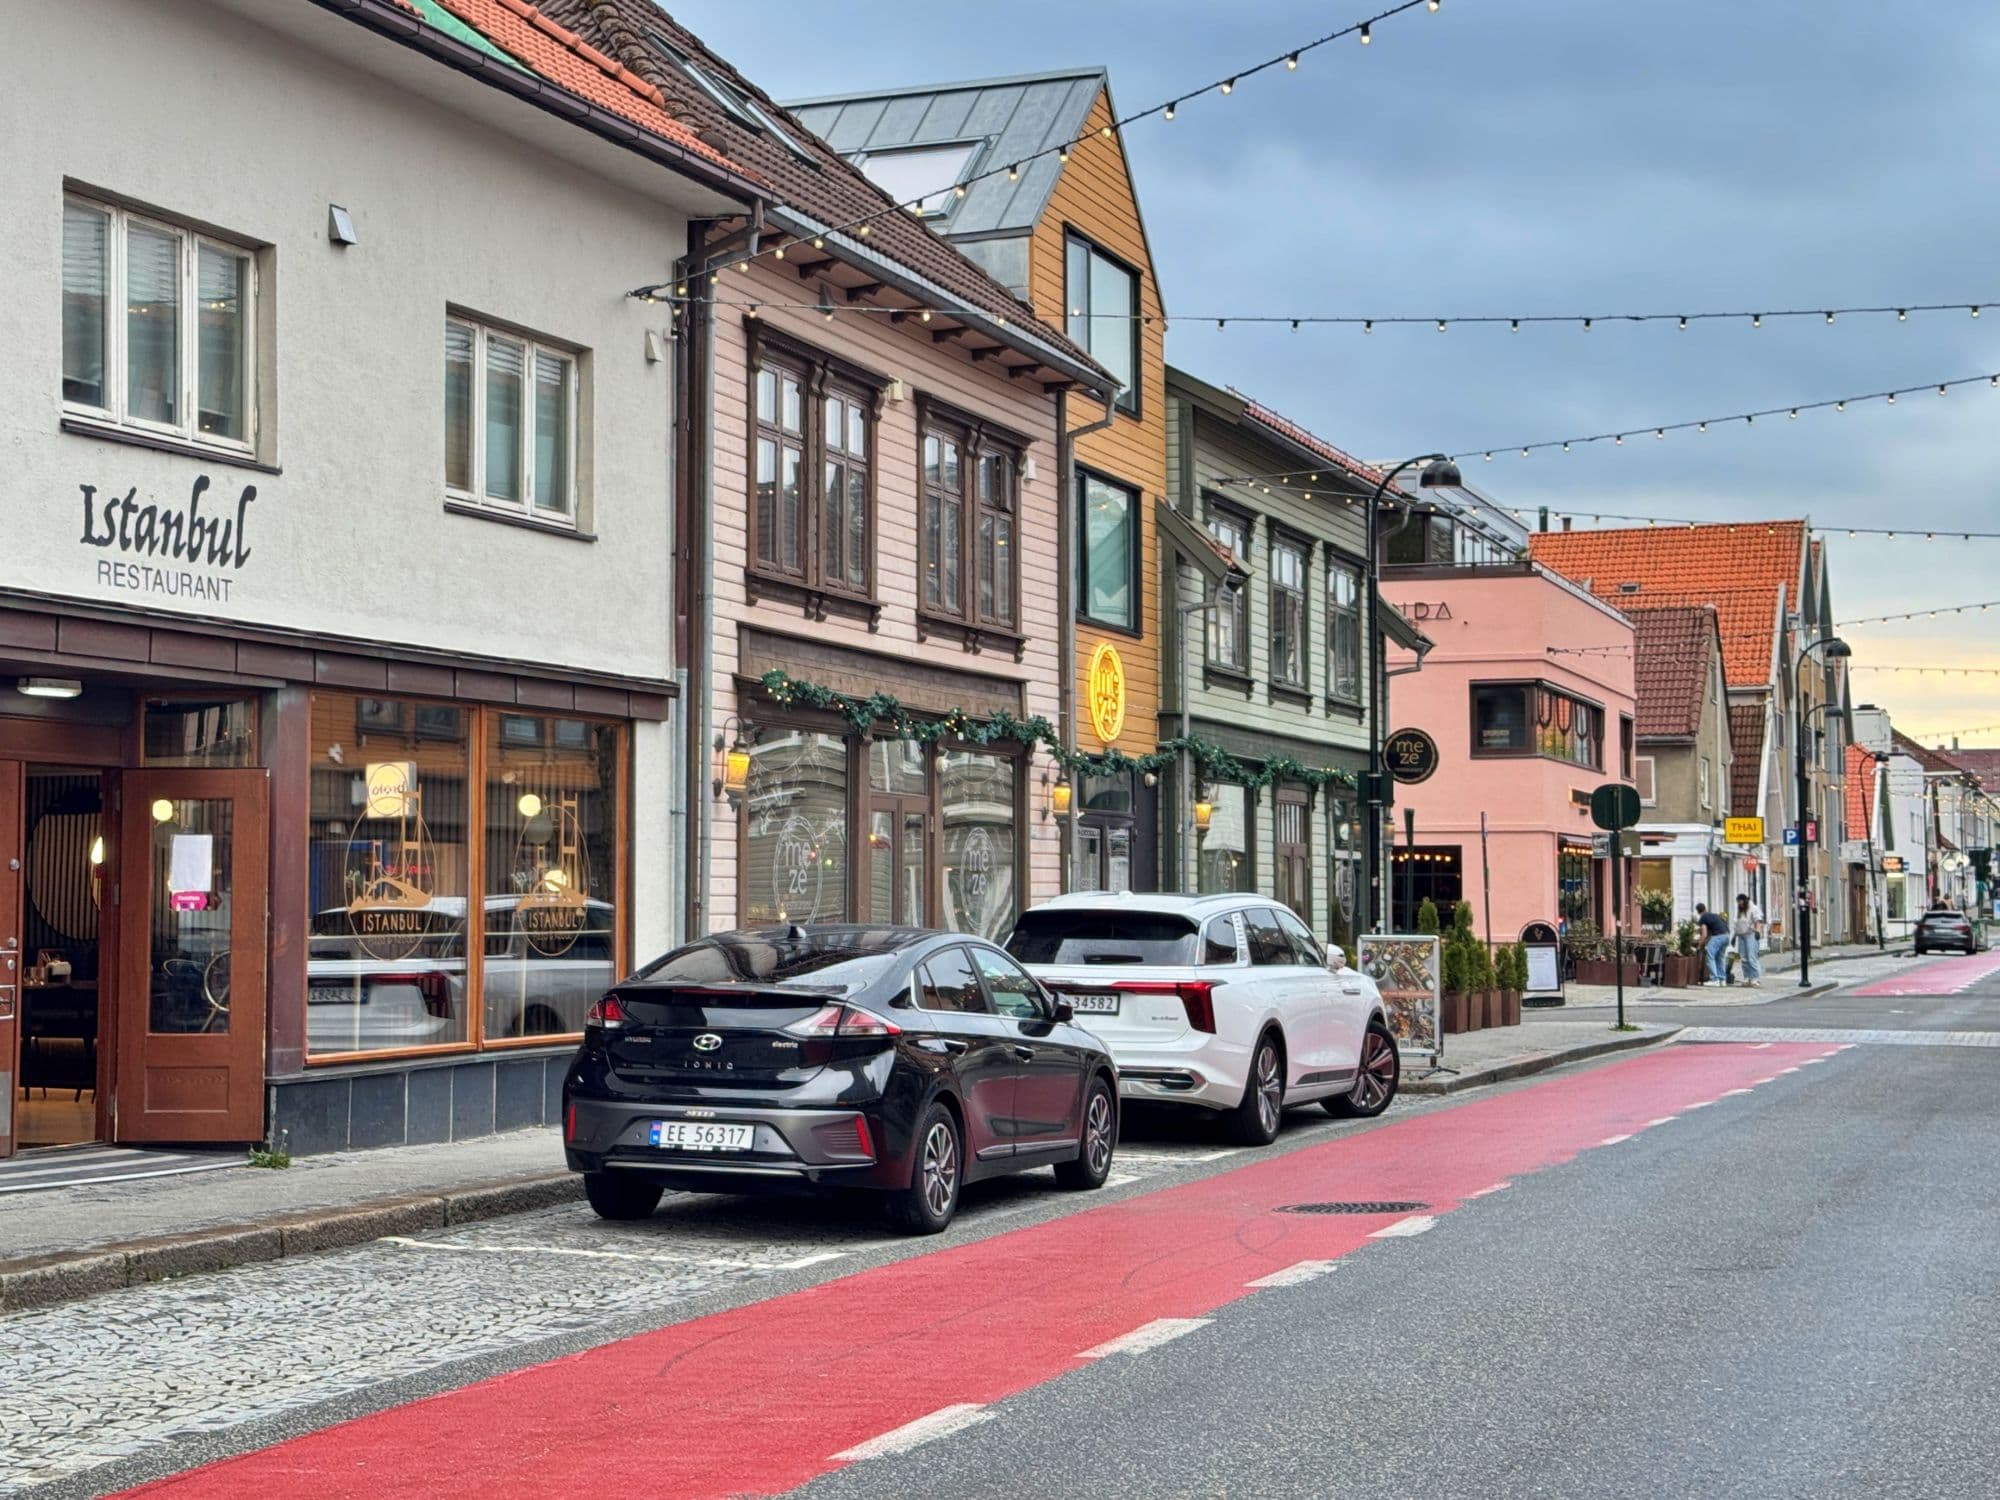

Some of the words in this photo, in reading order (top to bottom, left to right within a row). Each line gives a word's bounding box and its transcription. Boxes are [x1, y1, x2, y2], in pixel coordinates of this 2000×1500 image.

[79, 474, 257, 569] Istanbul
[97, 559, 233, 602] RESTAURANT
[1396, 740, 1424, 753] me
[1400, 752, 1420, 765] ze
[1731, 822, 1757, 831] THAI
[1786, 830, 1797, 844] P
[785, 841, 812, 867] me
[969, 850, 989, 872] me
[788, 869, 808, 894] ze
[971, 873, 987, 896] ze
[362, 912, 422, 932] ISTANBUL
[529, 911, 578, 929] ISTANBUL
[1073, 996, 1113, 1010] 34582
[667, 1125, 685, 1142] EE
[694, 1126, 746, 1145] 56317
